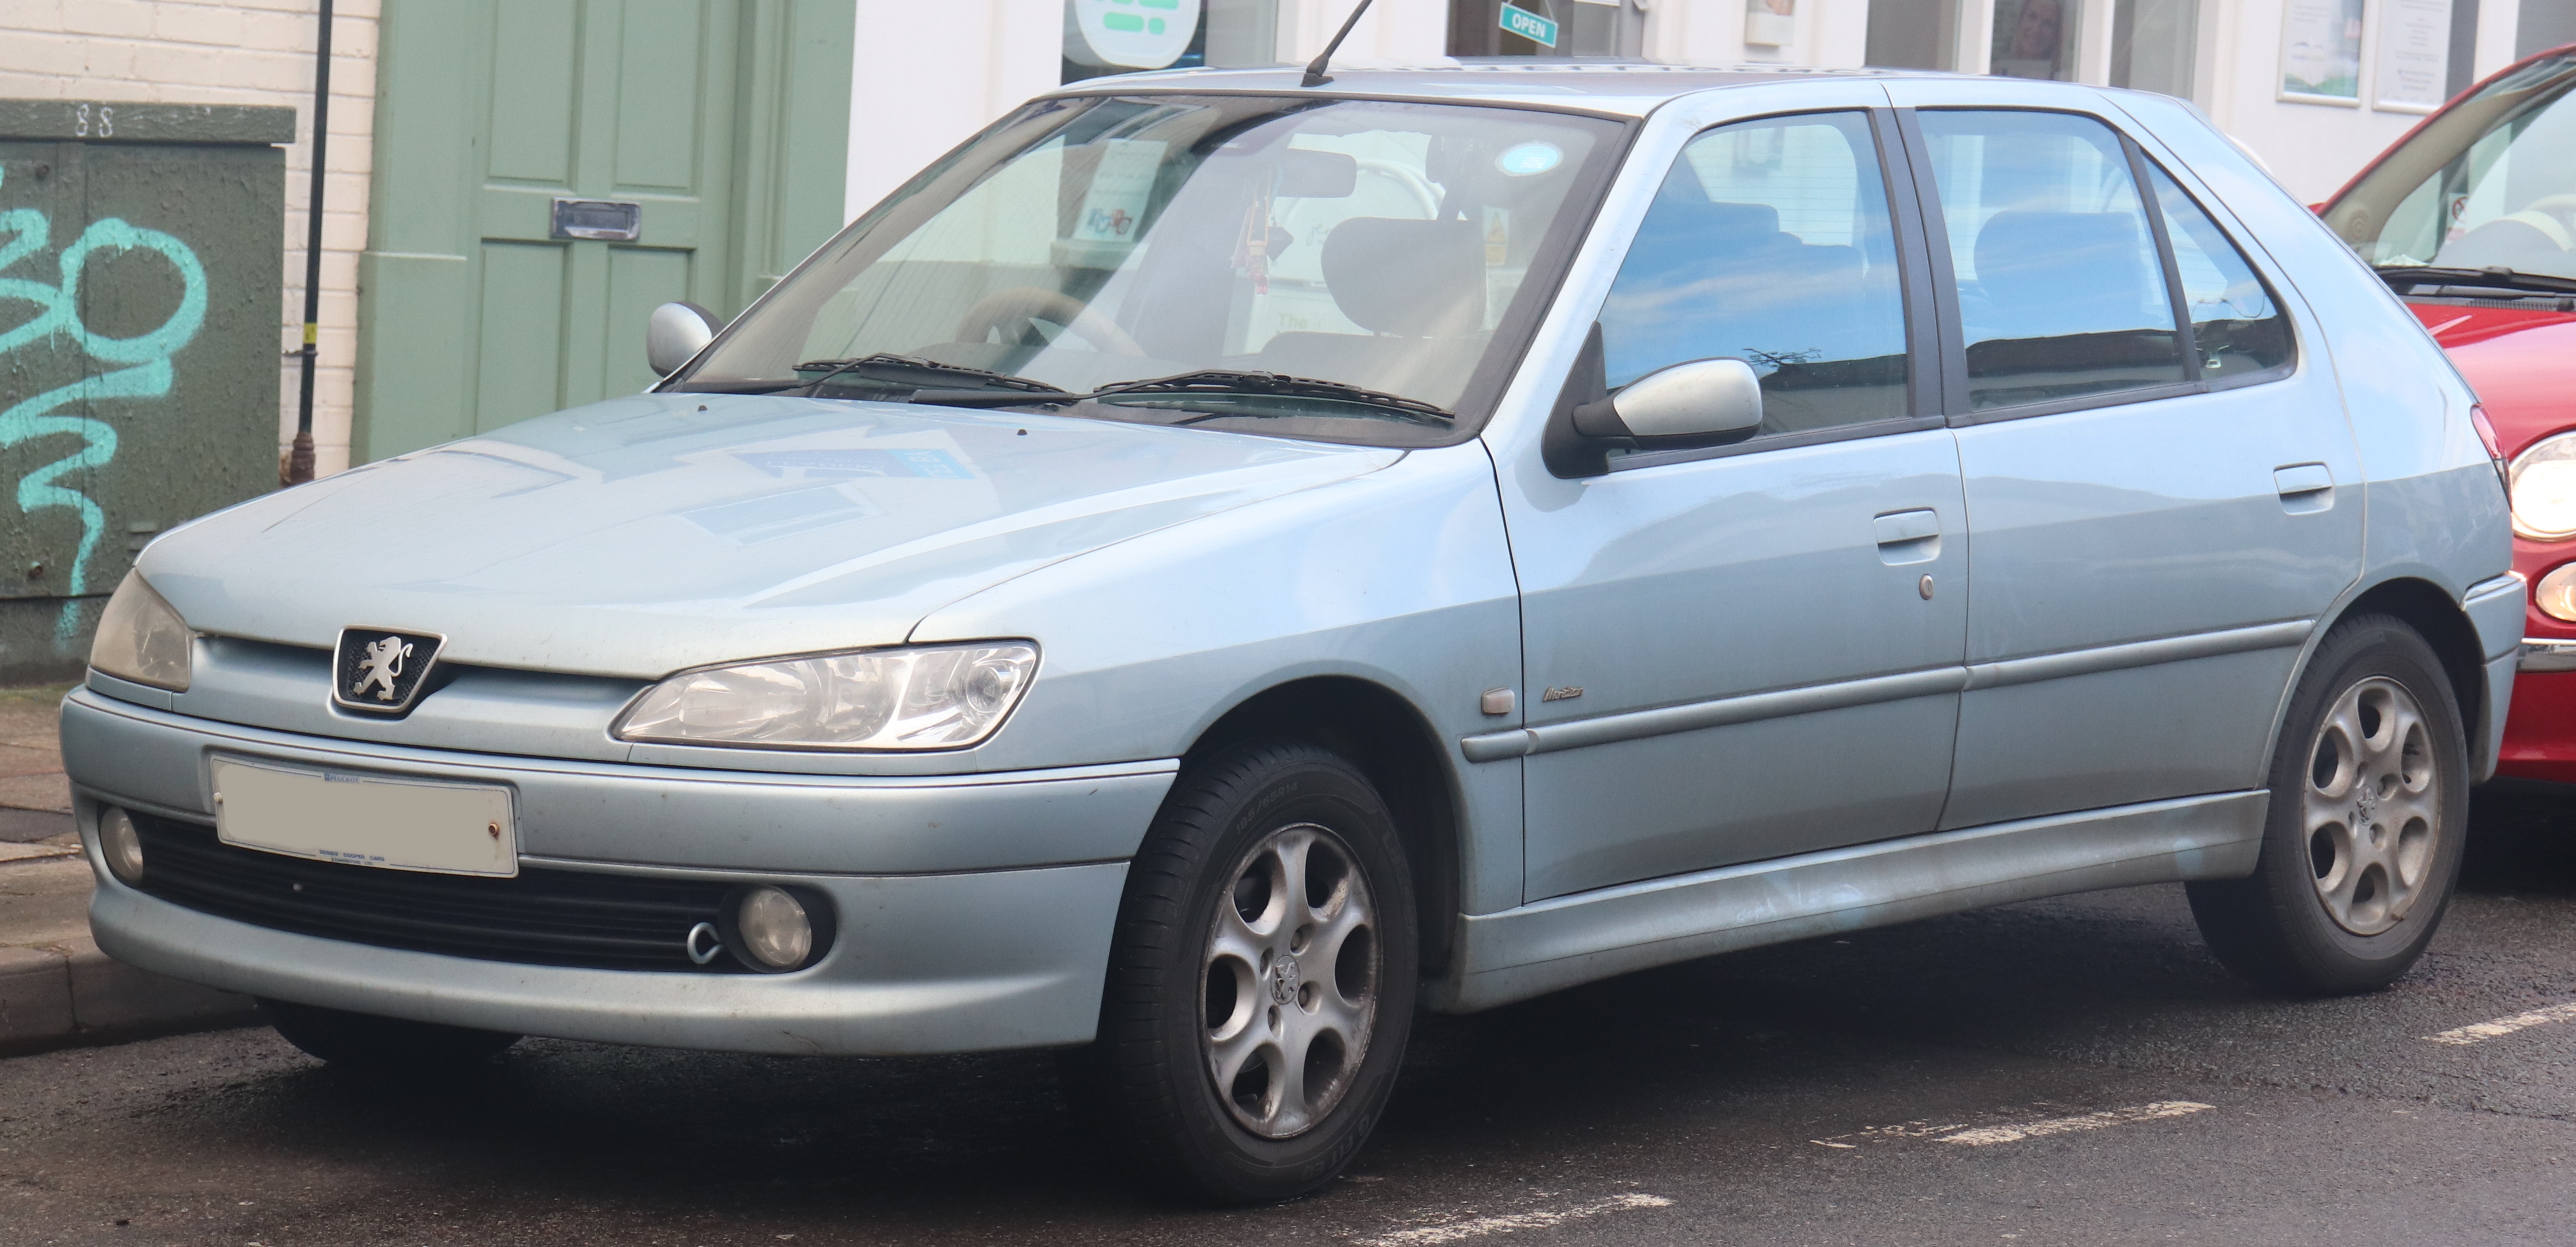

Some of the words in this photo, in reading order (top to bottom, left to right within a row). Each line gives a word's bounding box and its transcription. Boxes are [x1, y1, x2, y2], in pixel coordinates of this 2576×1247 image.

[1512, 12, 1547, 38] OPEN
[1279, 312, 1308, 329] The
[1543, 686, 1584, 702] Meridian
[329, 774, 359, 783] PEUGEOT
[1236, 782, 1298, 835] 185/65R14
[1328, 1135, 1353, 1168] FIT
